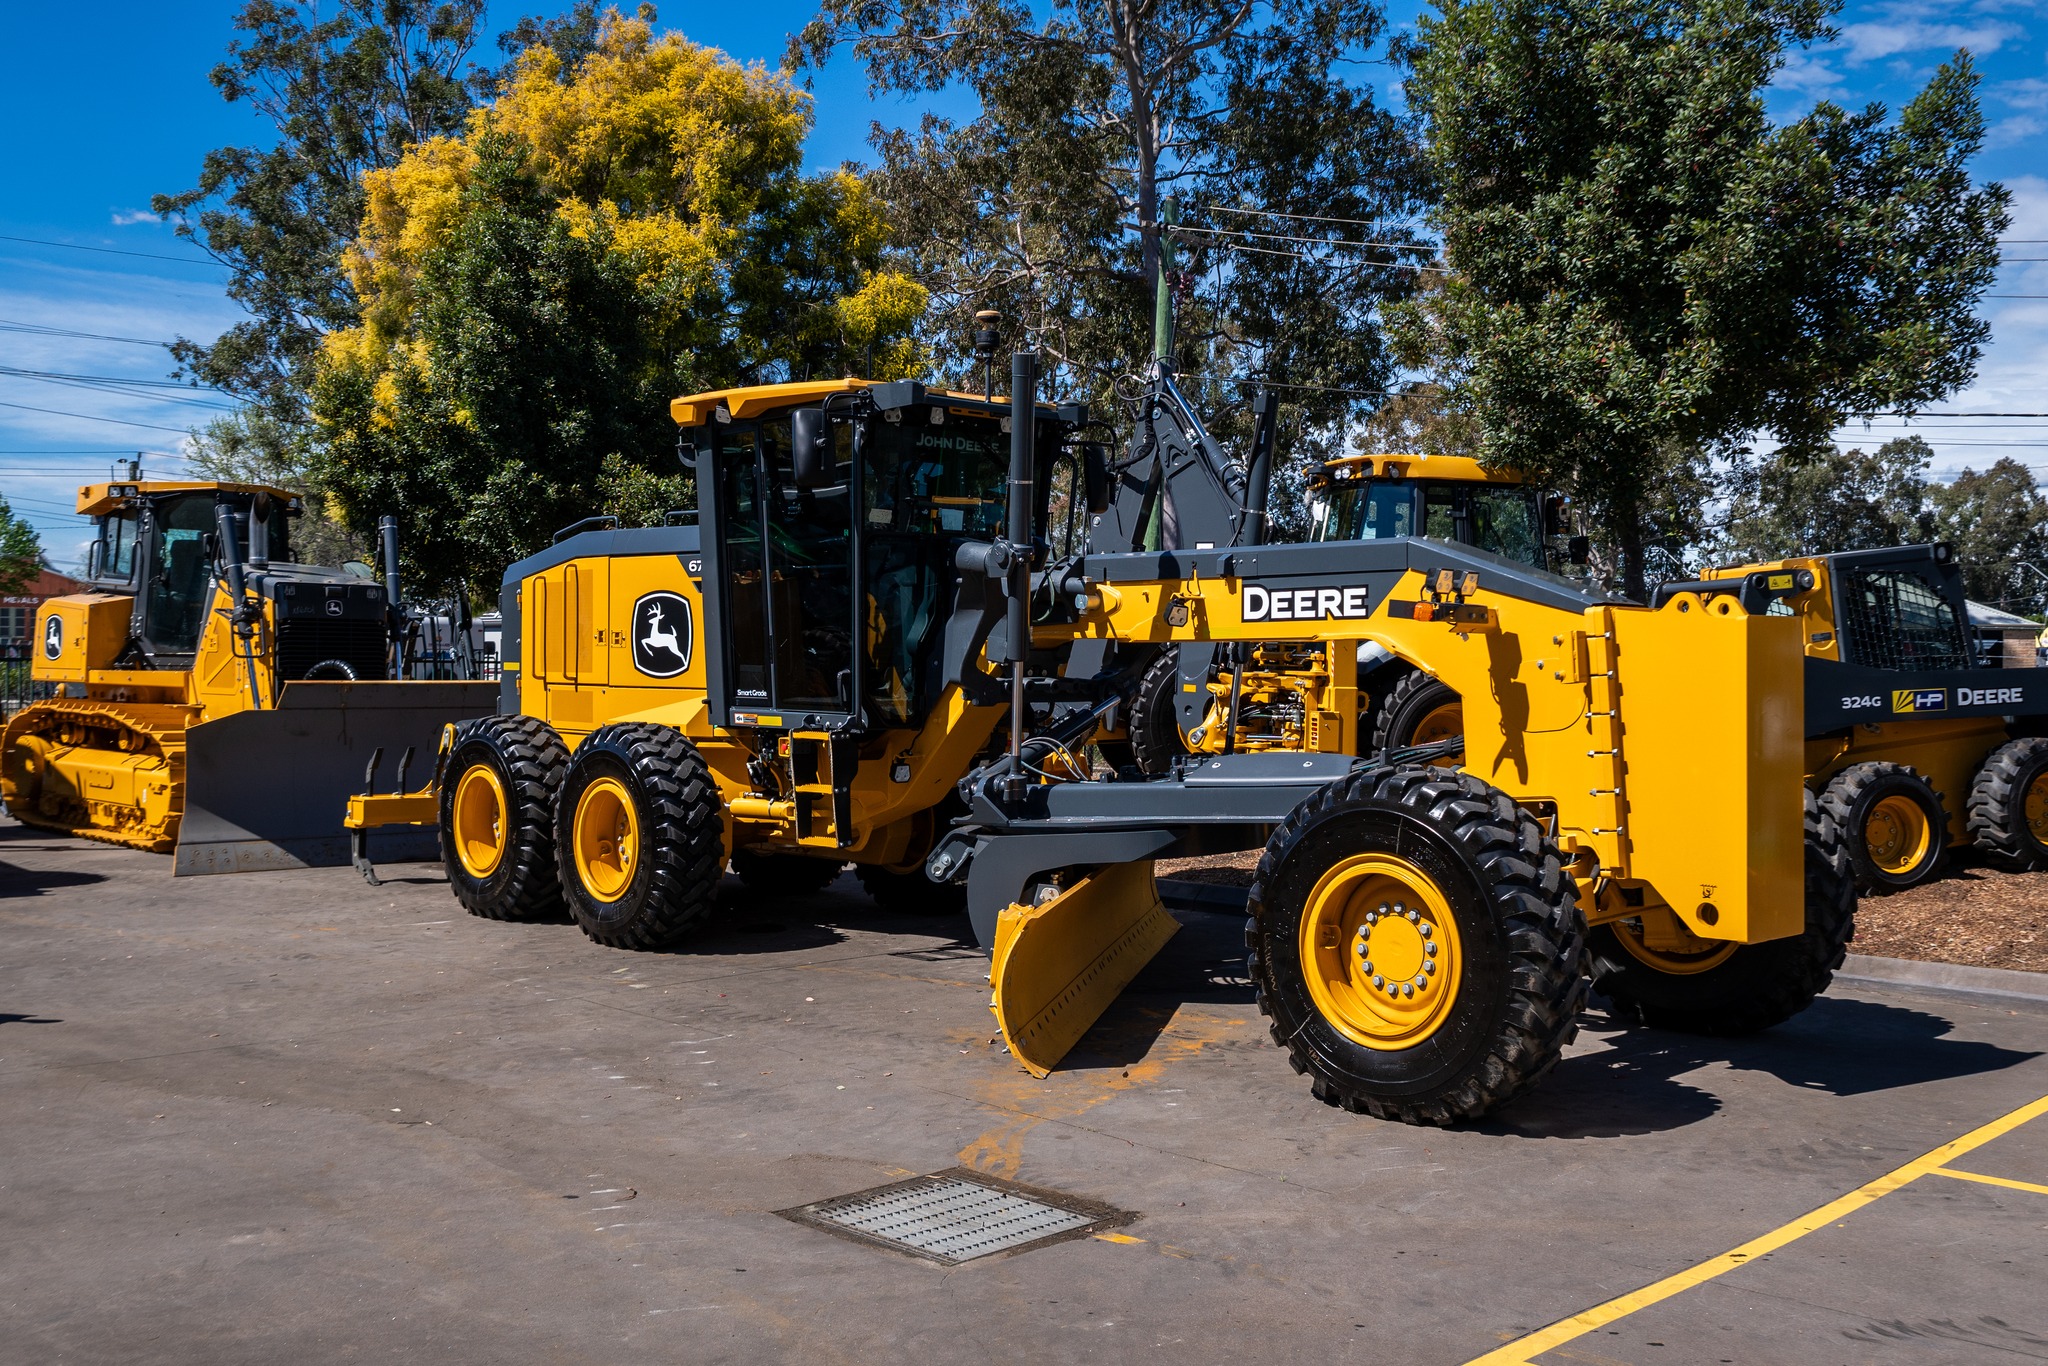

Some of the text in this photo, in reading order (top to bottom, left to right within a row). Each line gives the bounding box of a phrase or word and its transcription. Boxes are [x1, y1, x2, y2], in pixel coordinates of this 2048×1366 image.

[916, 433, 1000, 454] JOHN DEEE
[1243, 586, 1367, 620] DEERE
[1841, 695, 1882, 709] 324G
[1915, 693, 1943, 708] HP
[1957, 687, 2024, 706] DEERE
